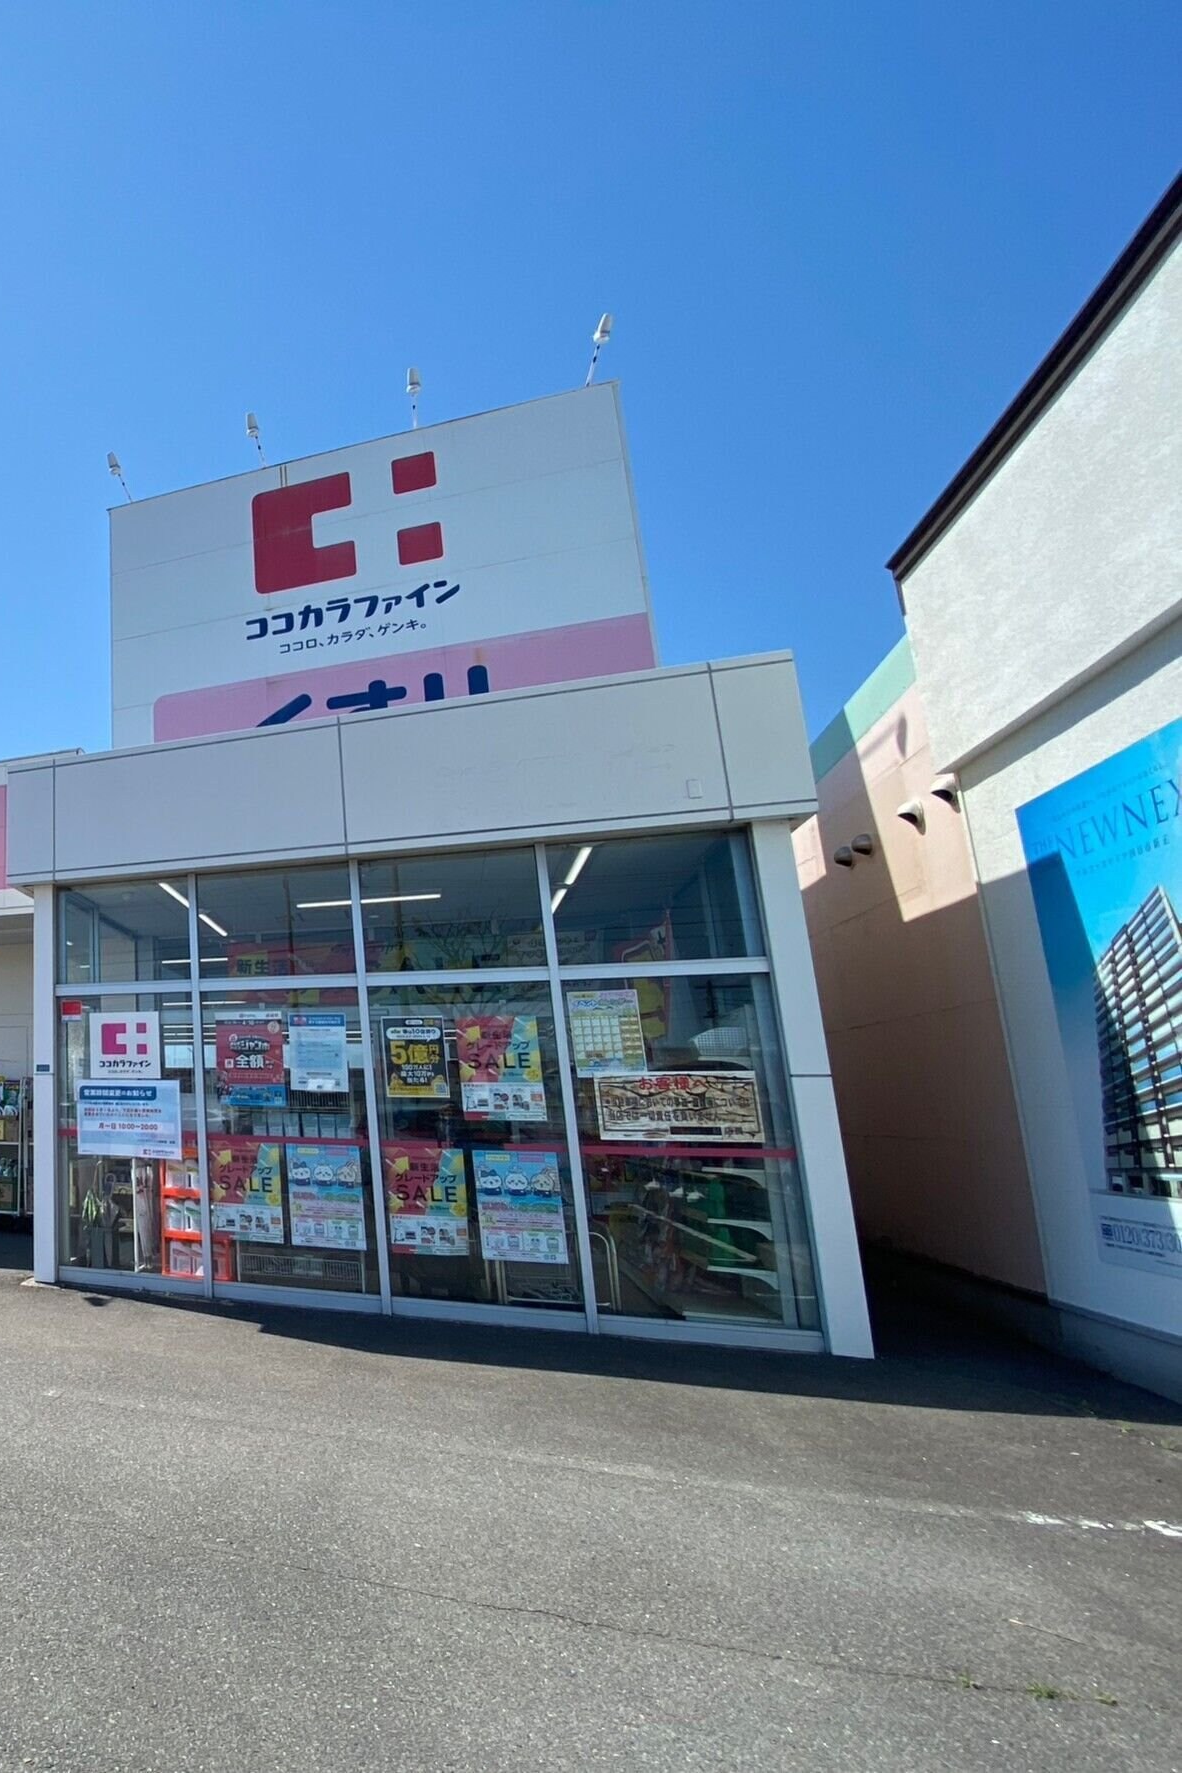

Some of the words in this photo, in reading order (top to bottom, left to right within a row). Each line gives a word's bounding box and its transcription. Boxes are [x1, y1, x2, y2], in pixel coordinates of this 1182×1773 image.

[245, 579, 461, 642] ココカラファイン
[279, 619, 428, 655] ココロ、カラダ、ゲンキ。
[99, 1059, 152, 1068] ココカラファイン
[235, 1054, 265, 1069] 全額
[467, 1052, 531, 1069] SALE
[638, 1076, 709, 1090] お客様へ
[219, 1175, 273, 1193] SALE
[396, 1184, 458, 1203] SALE
